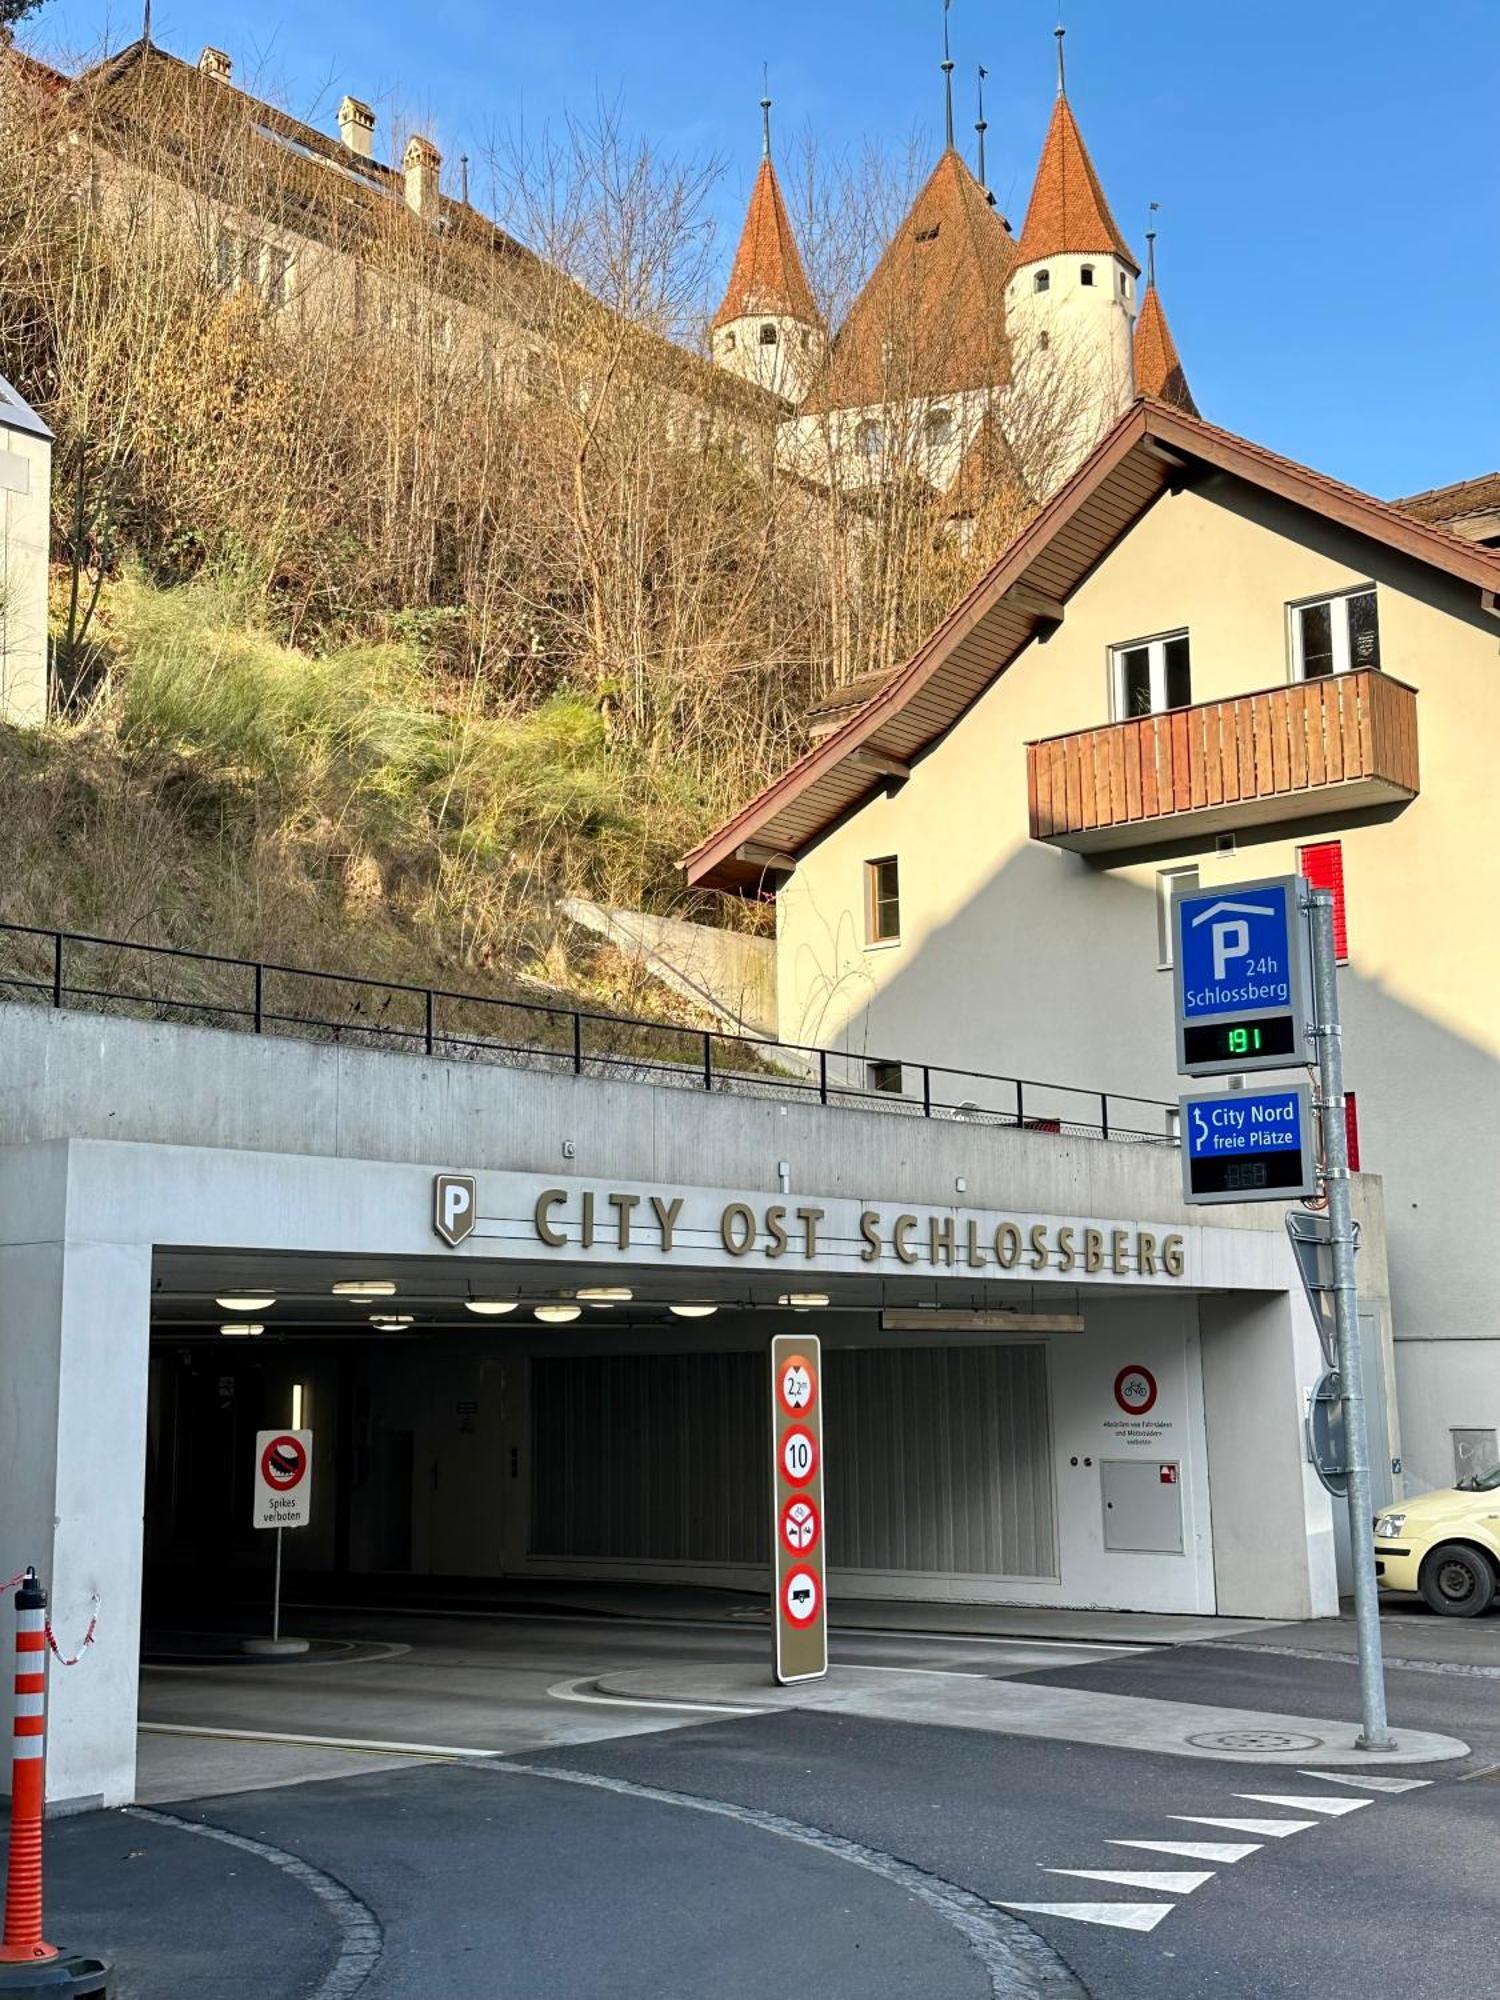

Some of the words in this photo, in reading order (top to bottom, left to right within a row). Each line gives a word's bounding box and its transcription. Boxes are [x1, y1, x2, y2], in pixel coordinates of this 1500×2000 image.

[1245, 957, 1277, 977] 24h
[1186, 981, 1288, 1008] Schlossberg
[1228, 1028, 1260, 1053] 191
[1212, 1107, 1245, 1129] City
[1251, 1102, 1294, 1124] Nord
[1213, 1132, 1245, 1149] freie
[1249, 1129, 1293, 1146] Plätze
[443, 1185, 470, 1233] P
[534, 1188, 685, 1252] CITY
[721, 1202, 826, 1260] OST
[859, 1209, 1186, 1279] SCHLOSSBERG
[789, 1443, 808, 1469] 10
[263, 1511, 301, 1523] verboten
[268, 1498, 296, 1511] Spikes
